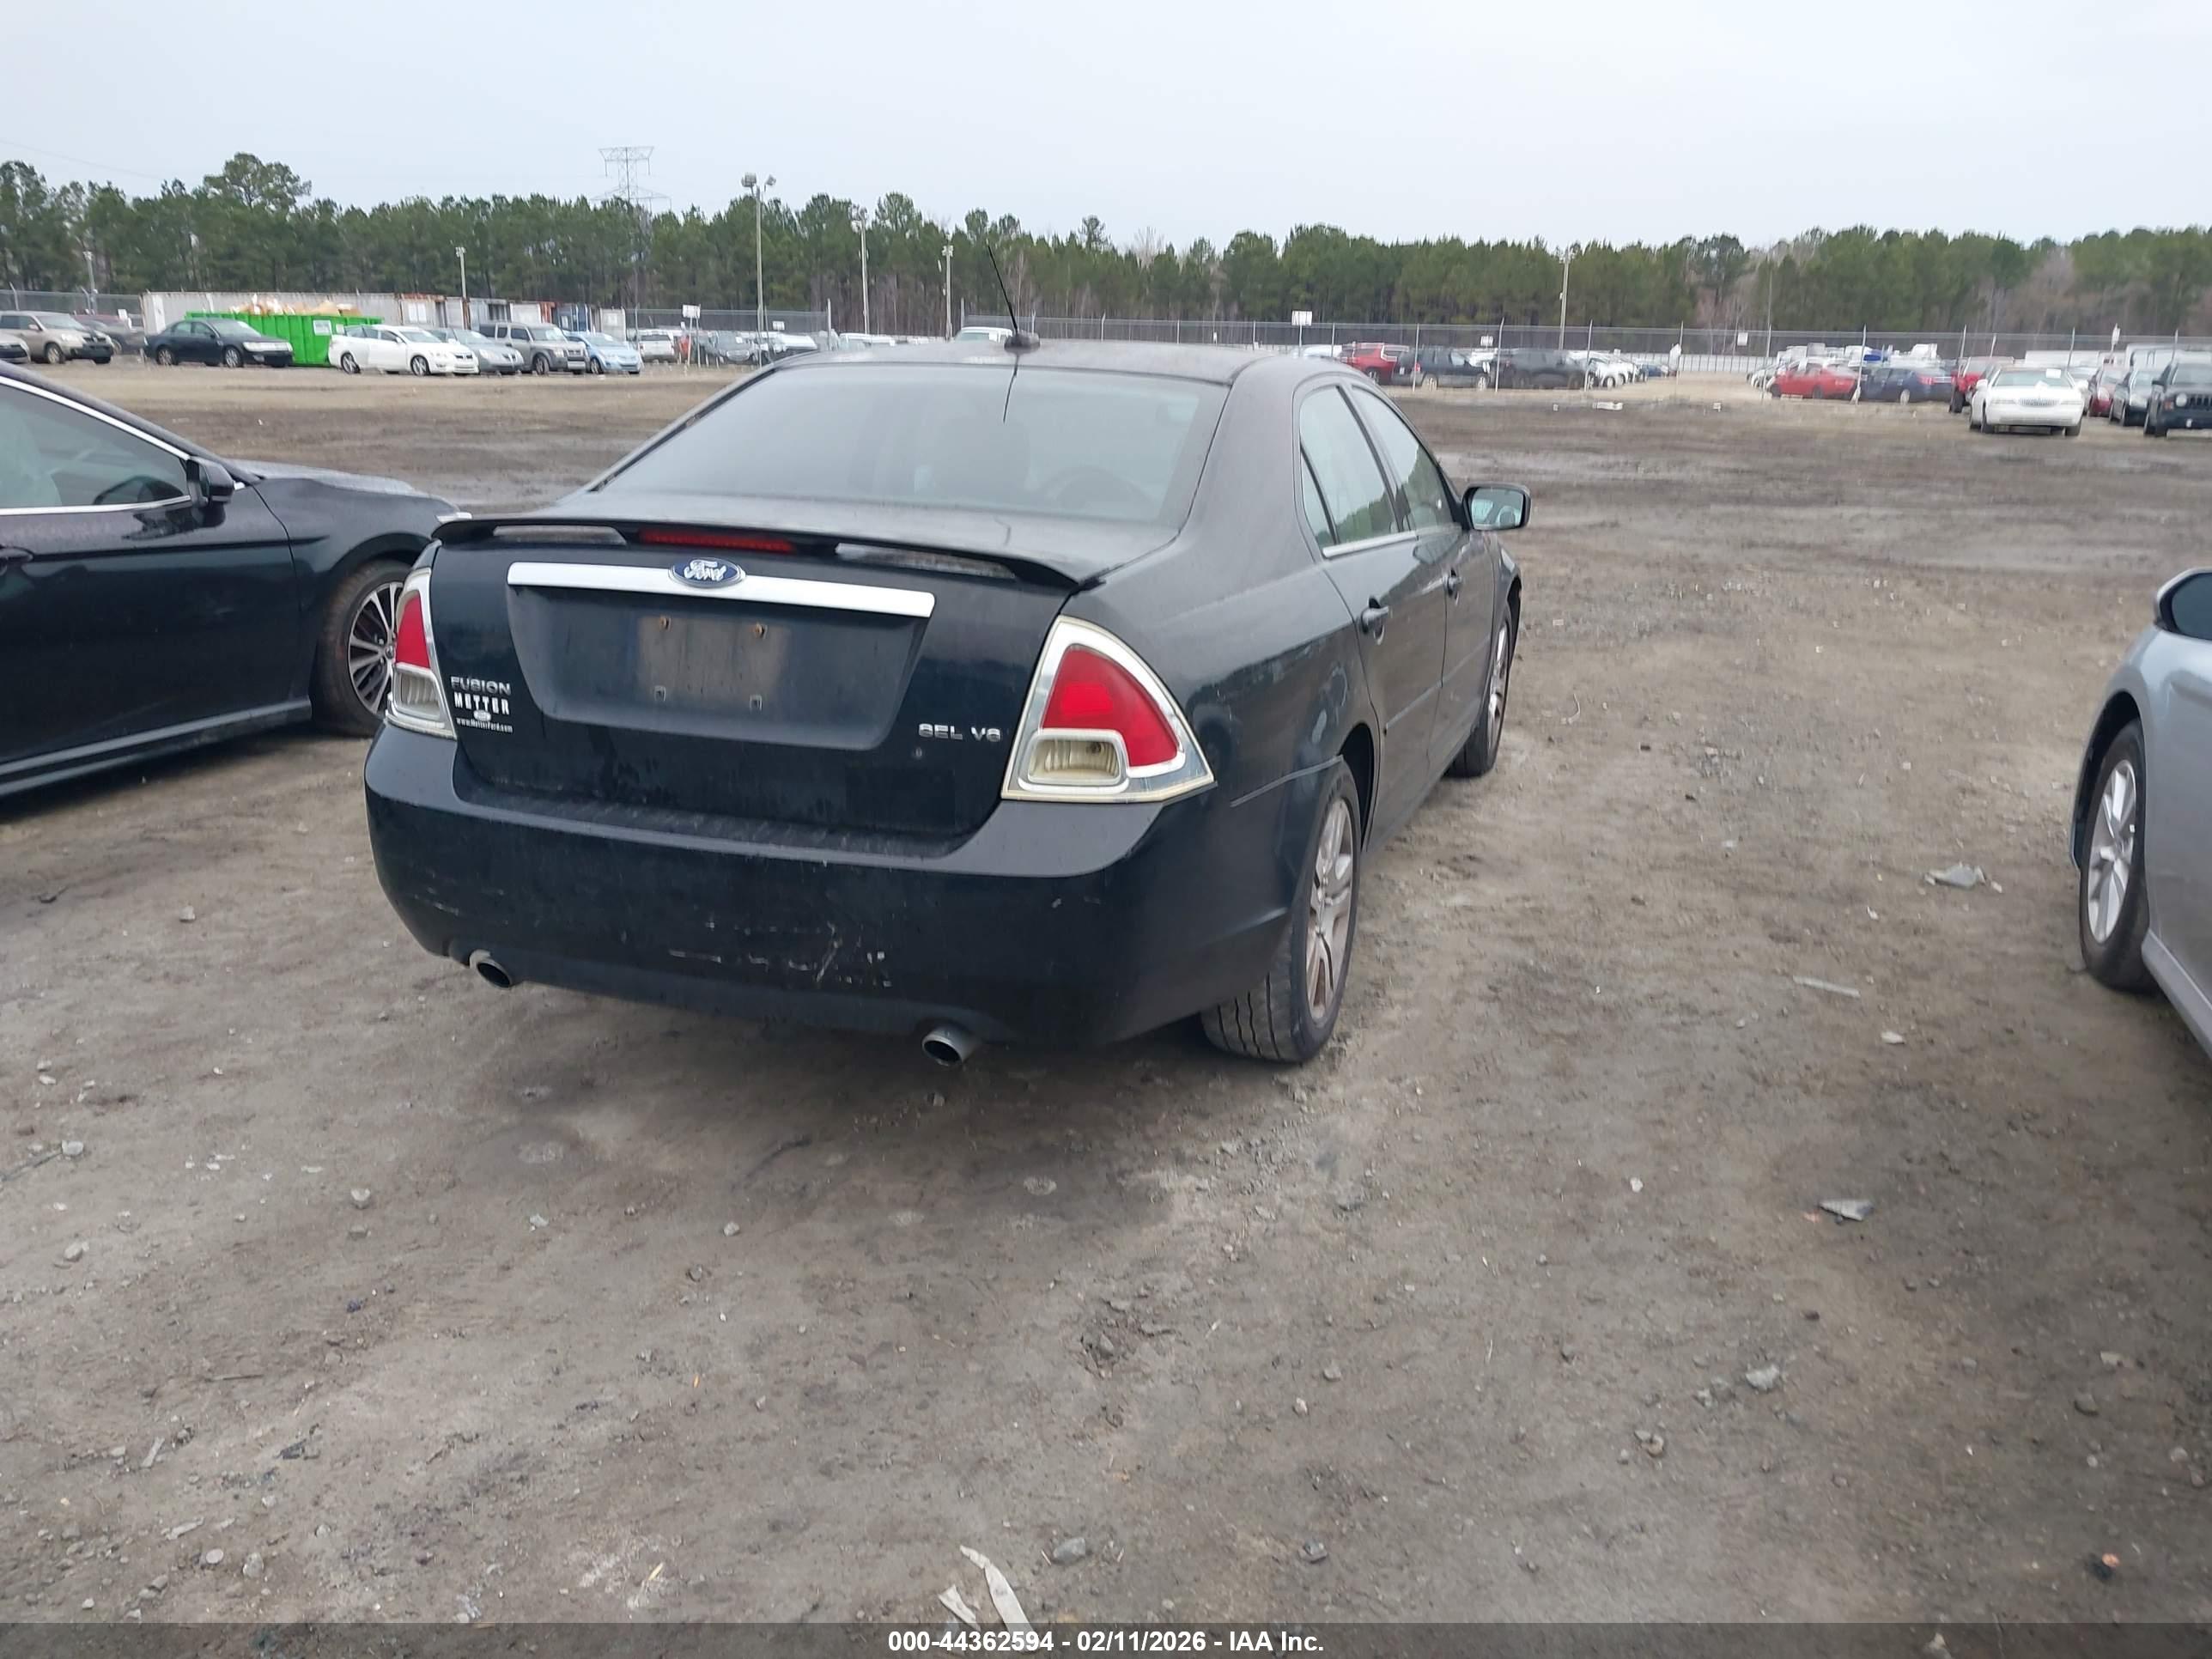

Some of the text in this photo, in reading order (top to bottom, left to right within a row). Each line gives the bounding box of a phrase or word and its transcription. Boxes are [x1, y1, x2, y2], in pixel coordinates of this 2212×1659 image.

[684, 559, 726, 582] Ford
[451, 676, 512, 696] FUSION
[918, 723, 1002, 743] SEL V6
